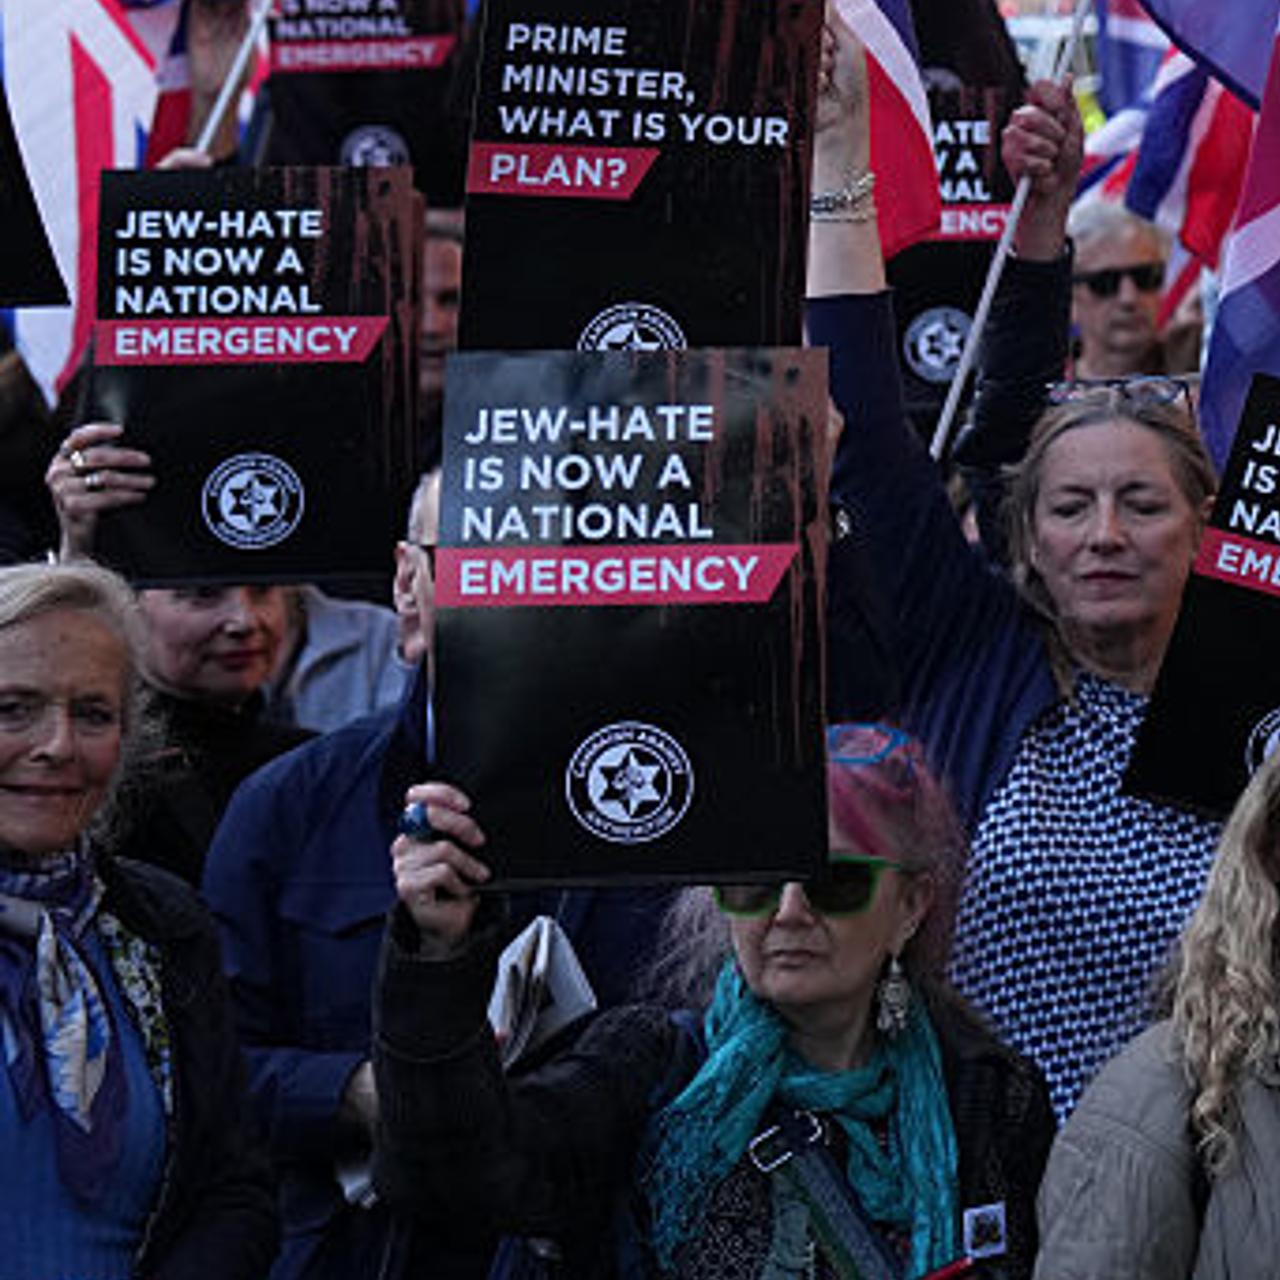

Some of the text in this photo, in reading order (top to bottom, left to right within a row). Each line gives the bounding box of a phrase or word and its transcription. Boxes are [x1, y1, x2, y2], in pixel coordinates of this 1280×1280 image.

[276, 16, 410, 39] NATIONAL
[507, 23, 627, 56] PRIME
[278, 42, 436, 65] EMERGENCY
[503, 64, 696, 104] MINISTER,
[499, 106, 789, 147] WHAT IS YOUR
[490, 154, 627, 189] PLAN?
[116, 210, 324, 240] JEW-HATE
[117, 247, 304, 276] IS NOW A
[116, 285, 322, 314] NATIONAL
[115, 326, 358, 356] EMERGENCY
[464, 405, 714, 445] JEW-HATE
[463, 454, 691, 492] IS NOW A
[1242, 460, 1277, 494] IS
[461, 503, 714, 542] NATIONAL
[460, 555, 759, 595] EMERGENCY
